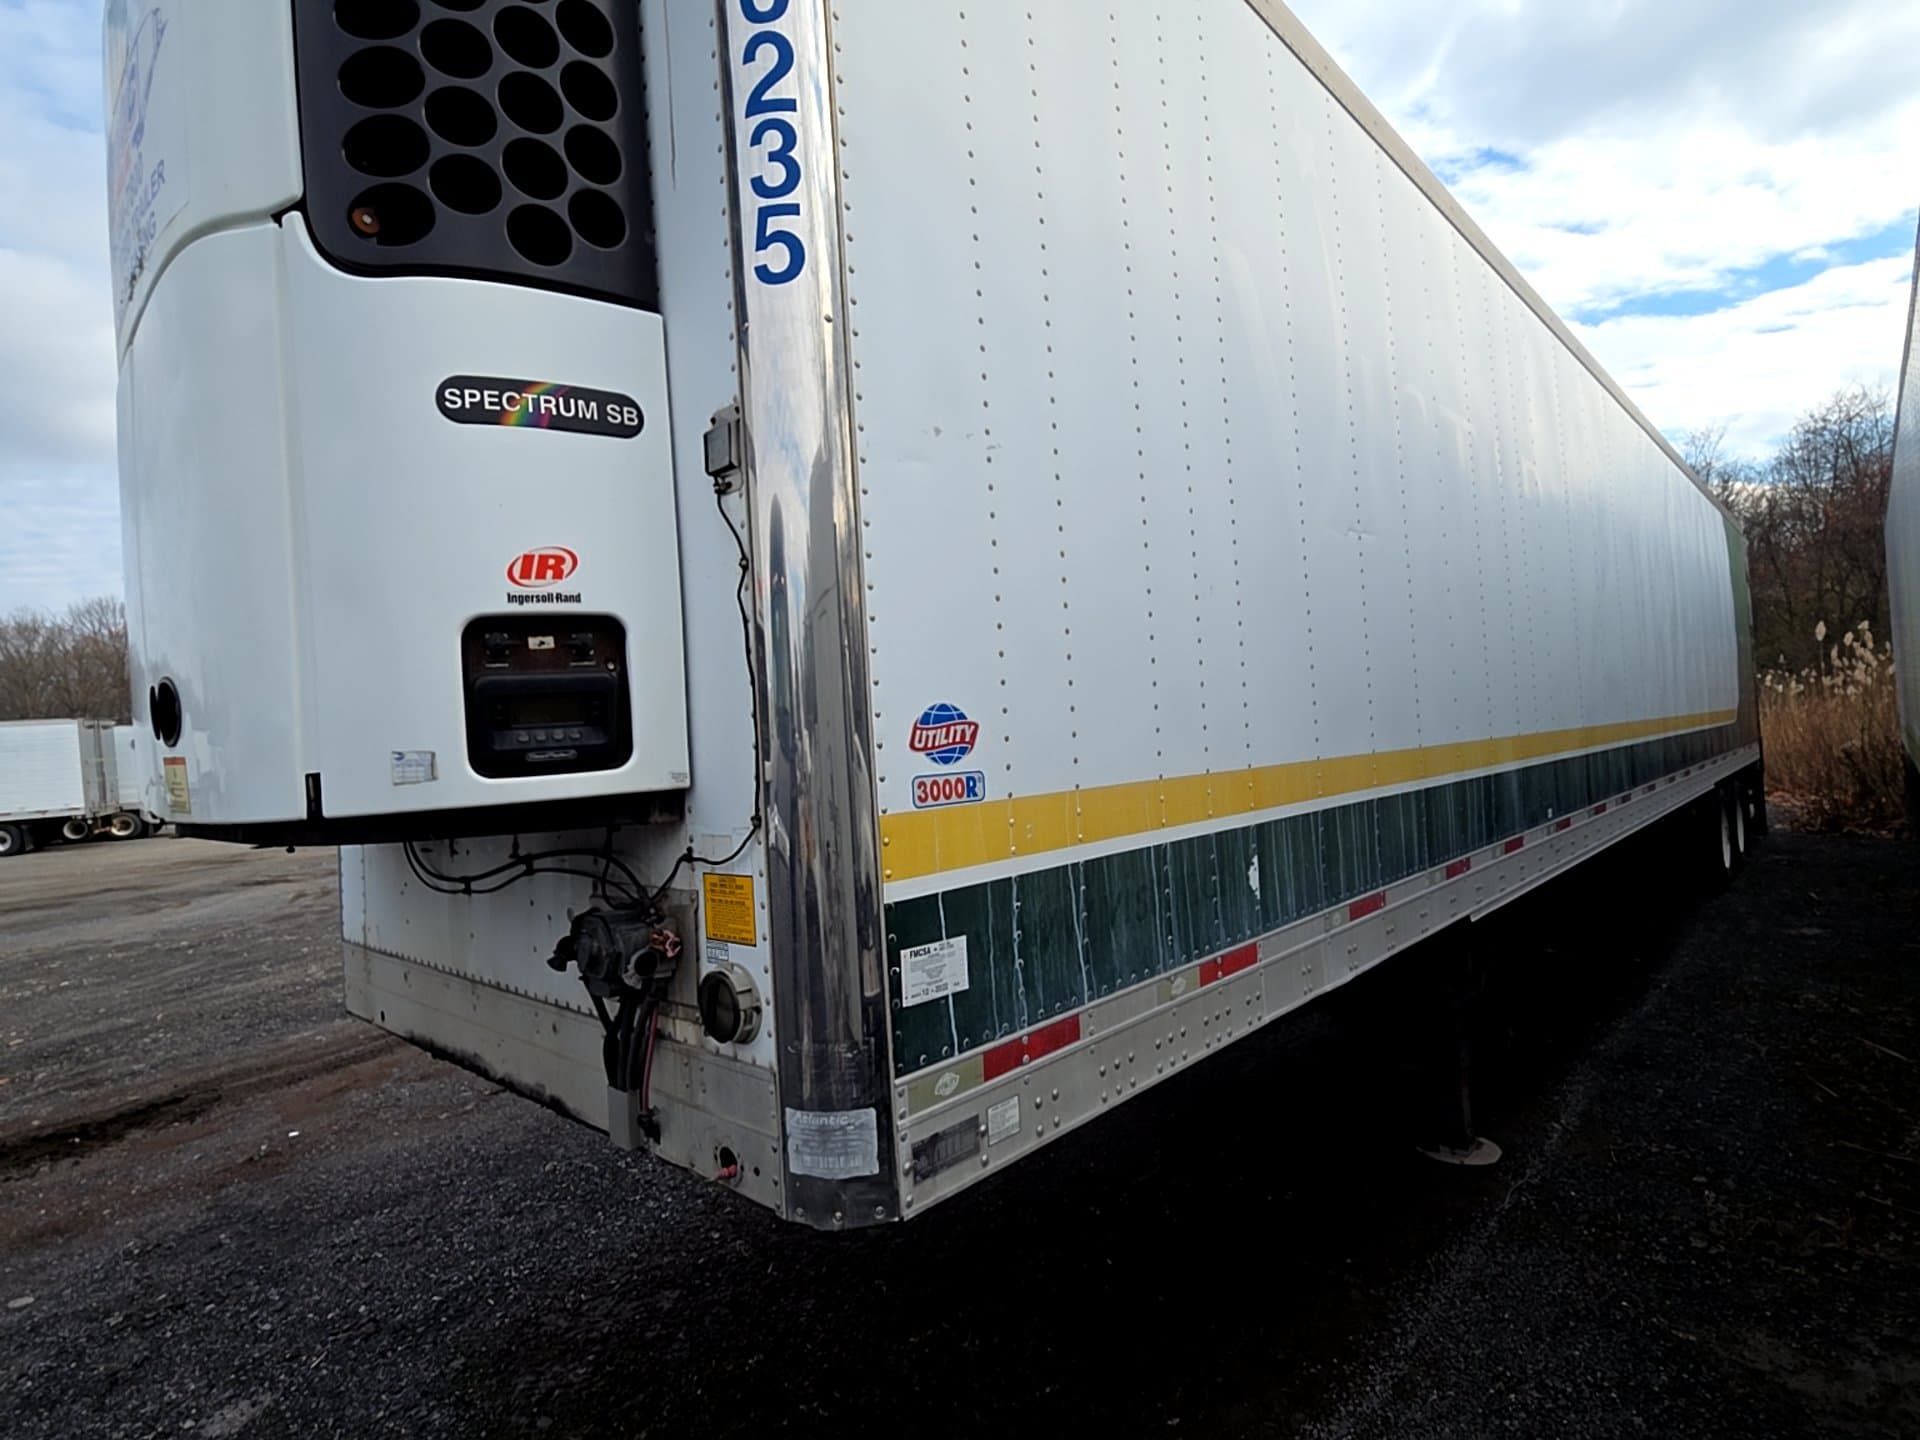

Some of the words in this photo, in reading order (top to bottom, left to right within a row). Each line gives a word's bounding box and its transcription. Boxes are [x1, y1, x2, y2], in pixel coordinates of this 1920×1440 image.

[739, 0, 806, 285] 235
[443, 387, 599, 421] SPECTRUM
[606, 404, 639, 426] SB
[518, 553, 567, 580] IR
[914, 724, 976, 749] UTILITY
[917, 775, 979, 804] 3000R
